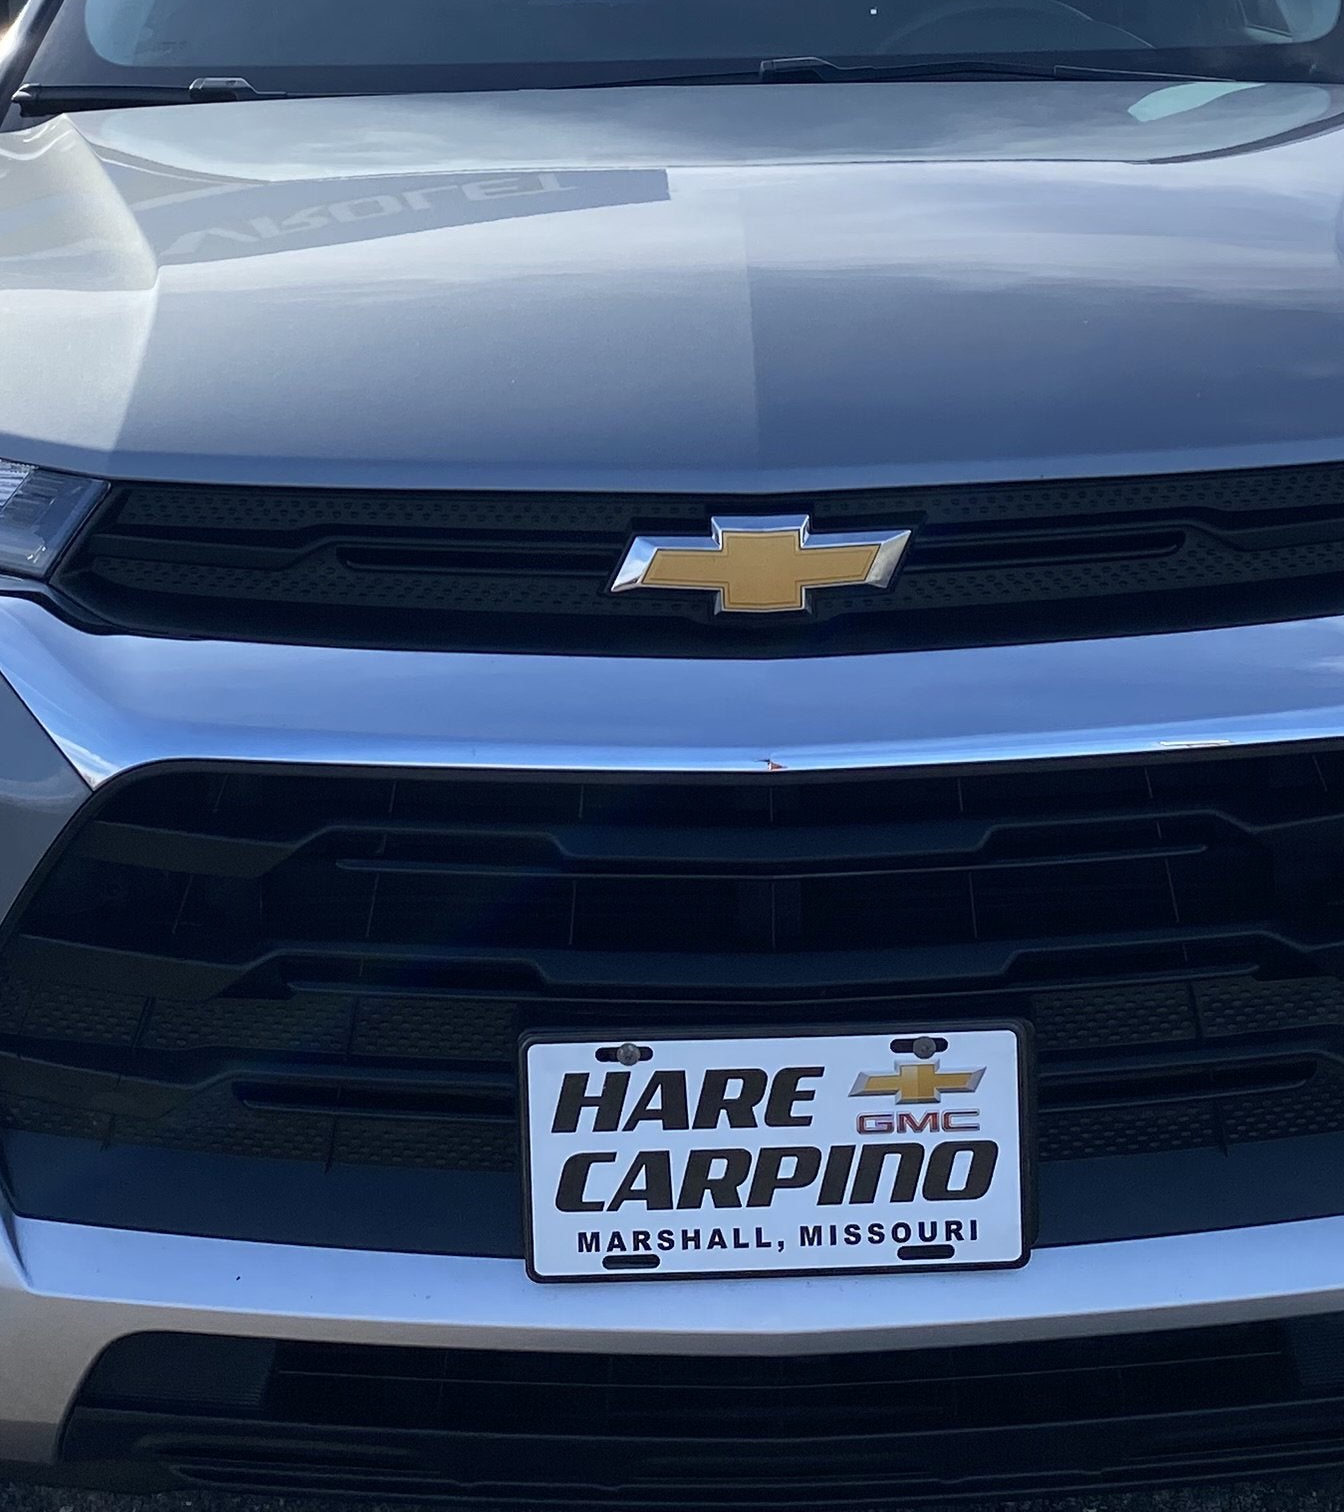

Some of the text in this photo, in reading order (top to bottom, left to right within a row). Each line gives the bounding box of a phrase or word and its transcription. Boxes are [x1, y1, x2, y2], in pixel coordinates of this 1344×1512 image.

[551, 1066, 824, 1133] HARE
[857, 1110, 981, 1135] GMC
[556, 1140, 999, 1212] CARPINO
[577, 1220, 978, 1253] MARSHALL, MISSOURI
